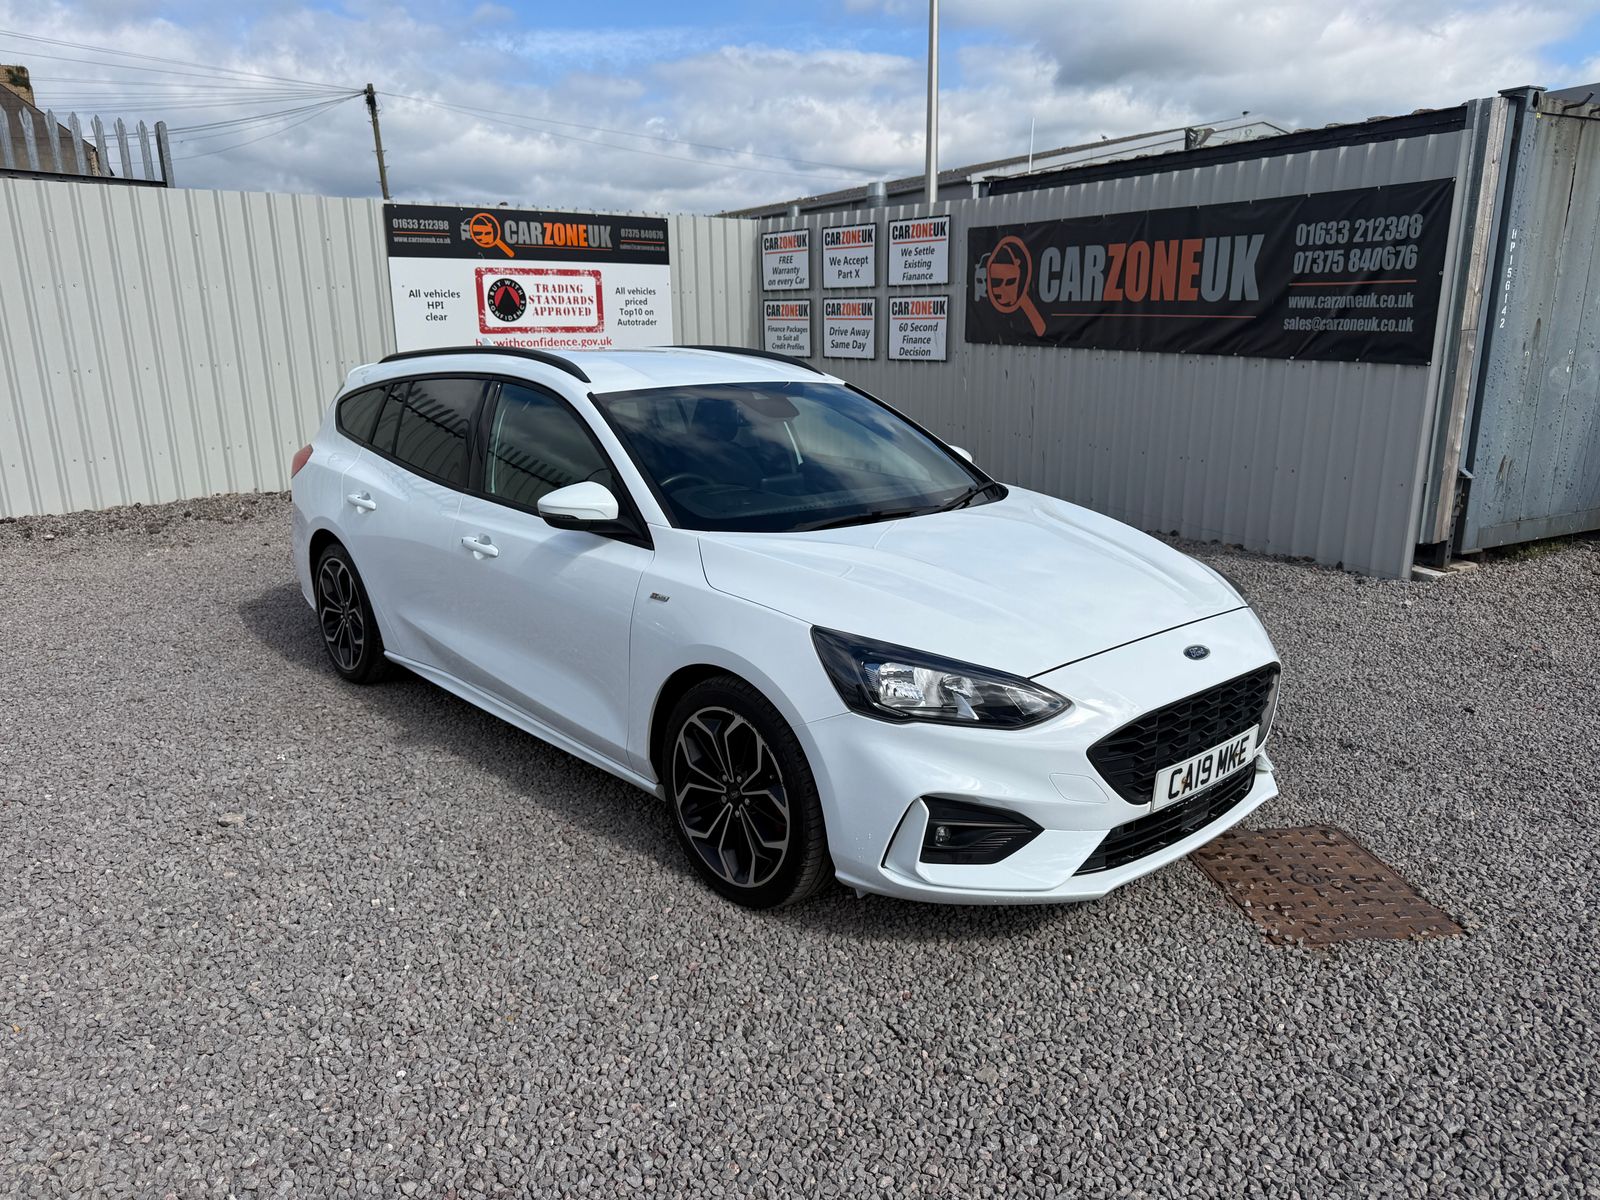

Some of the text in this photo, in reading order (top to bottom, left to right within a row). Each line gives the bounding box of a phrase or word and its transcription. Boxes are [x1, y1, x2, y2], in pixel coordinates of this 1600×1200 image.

[393, 218, 449, 230] 01633 212398
[504, 220, 613, 248] CARZONEUK
[892, 221, 947, 240] CARZONEUK
[1295, 214, 1424, 246] 01633 212398
[764, 233, 807, 251] CARZONEUK
[825, 228, 873, 246] CARZONEUK
[901, 246, 935, 257] We Settle
[778, 256, 793, 264] FREE
[829, 255, 868, 267] We Accept
[904, 259, 932, 270] Existing
[1293, 244, 1418, 274] 07375 840676
[772, 266, 800, 276] Warranty
[837, 269, 860, 279] Part X
[1038, 234, 1264, 303] CARZONEUK
[777, 278, 793, 287] every
[794, 277, 805, 285] Car
[902, 272, 933, 281] Fianance
[490, 282, 502, 296] BUY
[505, 280, 523, 296] WITH
[534, 284, 583, 293] TRADING
[615, 287, 656, 296] All vehicles
[408, 289, 460, 299] All vehicles
[528, 295, 594, 305] STANDARDS
[625, 297, 648, 307] priced
[1288, 292, 1414, 309] www.carzoneuk.co.uk
[427, 302, 444, 310] HPI
[489, 299, 525, 321] CONFIDENCE
[533, 307, 592, 316] APPROVED
[766, 303, 808, 317] CARZONEUK
[825, 302, 873, 316] CARZONEUK
[892, 300, 946, 315] CARZONEUK
[425, 312, 448, 321] clear
[620, 308, 642, 317] Top10
[617, 318, 657, 326] Autotrader
[899, 322, 938, 332] 60 Second
[1283, 316, 1414, 332] sales@carzoneuk.co.uk
[786, 325, 808, 334] Packages
[829, 326, 870, 339] Drive Away
[475, 337, 613, 348] bwithconfidence.gov.uk
[902, 335, 931, 344] Finance
[772, 342, 805, 351] Credit Profiles
[830, 339, 866, 352] Same Day
[899, 347, 931, 356] Decision
[1168, 735, 1250, 800] CA19 MKE
